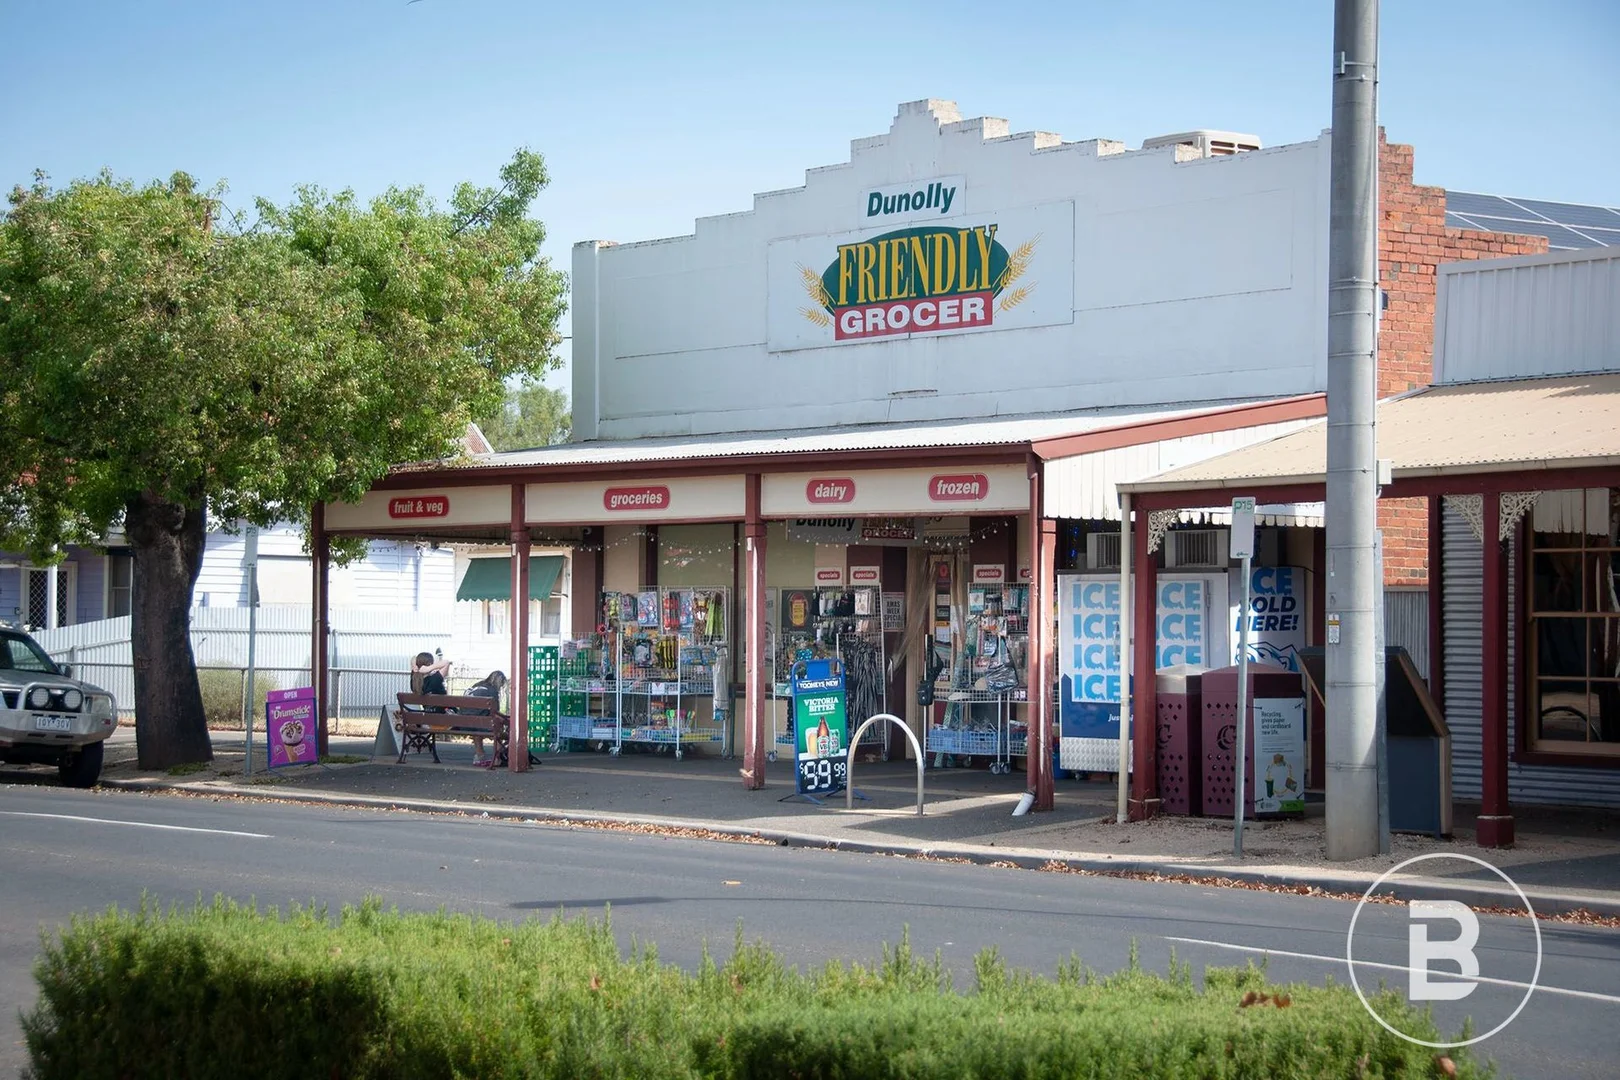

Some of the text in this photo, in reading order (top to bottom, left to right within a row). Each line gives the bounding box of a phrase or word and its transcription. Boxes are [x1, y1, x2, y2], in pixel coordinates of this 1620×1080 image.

[867, 182, 956, 217] Dunolly
[837, 224, 998, 306] FRIENDLY
[840, 297, 986, 334] GROCER
[815, 483, 846, 500] dairy
[936, 479, 979, 496] frozen
[394, 500, 442, 514] fruit & veg
[610, 492, 662, 507] groceries
[1252, 567, 1292, 596] CE
[1072, 583, 1121, 610] ICE
[1073, 614, 1121, 640] ICE
[1074, 644, 1121, 672] ICE
[284, 691, 298, 700] OPEN
[1074, 674, 1121, 700] ICE
[804, 696, 839, 706] VICTORIA
[808, 704, 836, 712] BITTER
[274, 706, 310, 720] Drumstick
[1108, 714, 1120, 722] Jus
